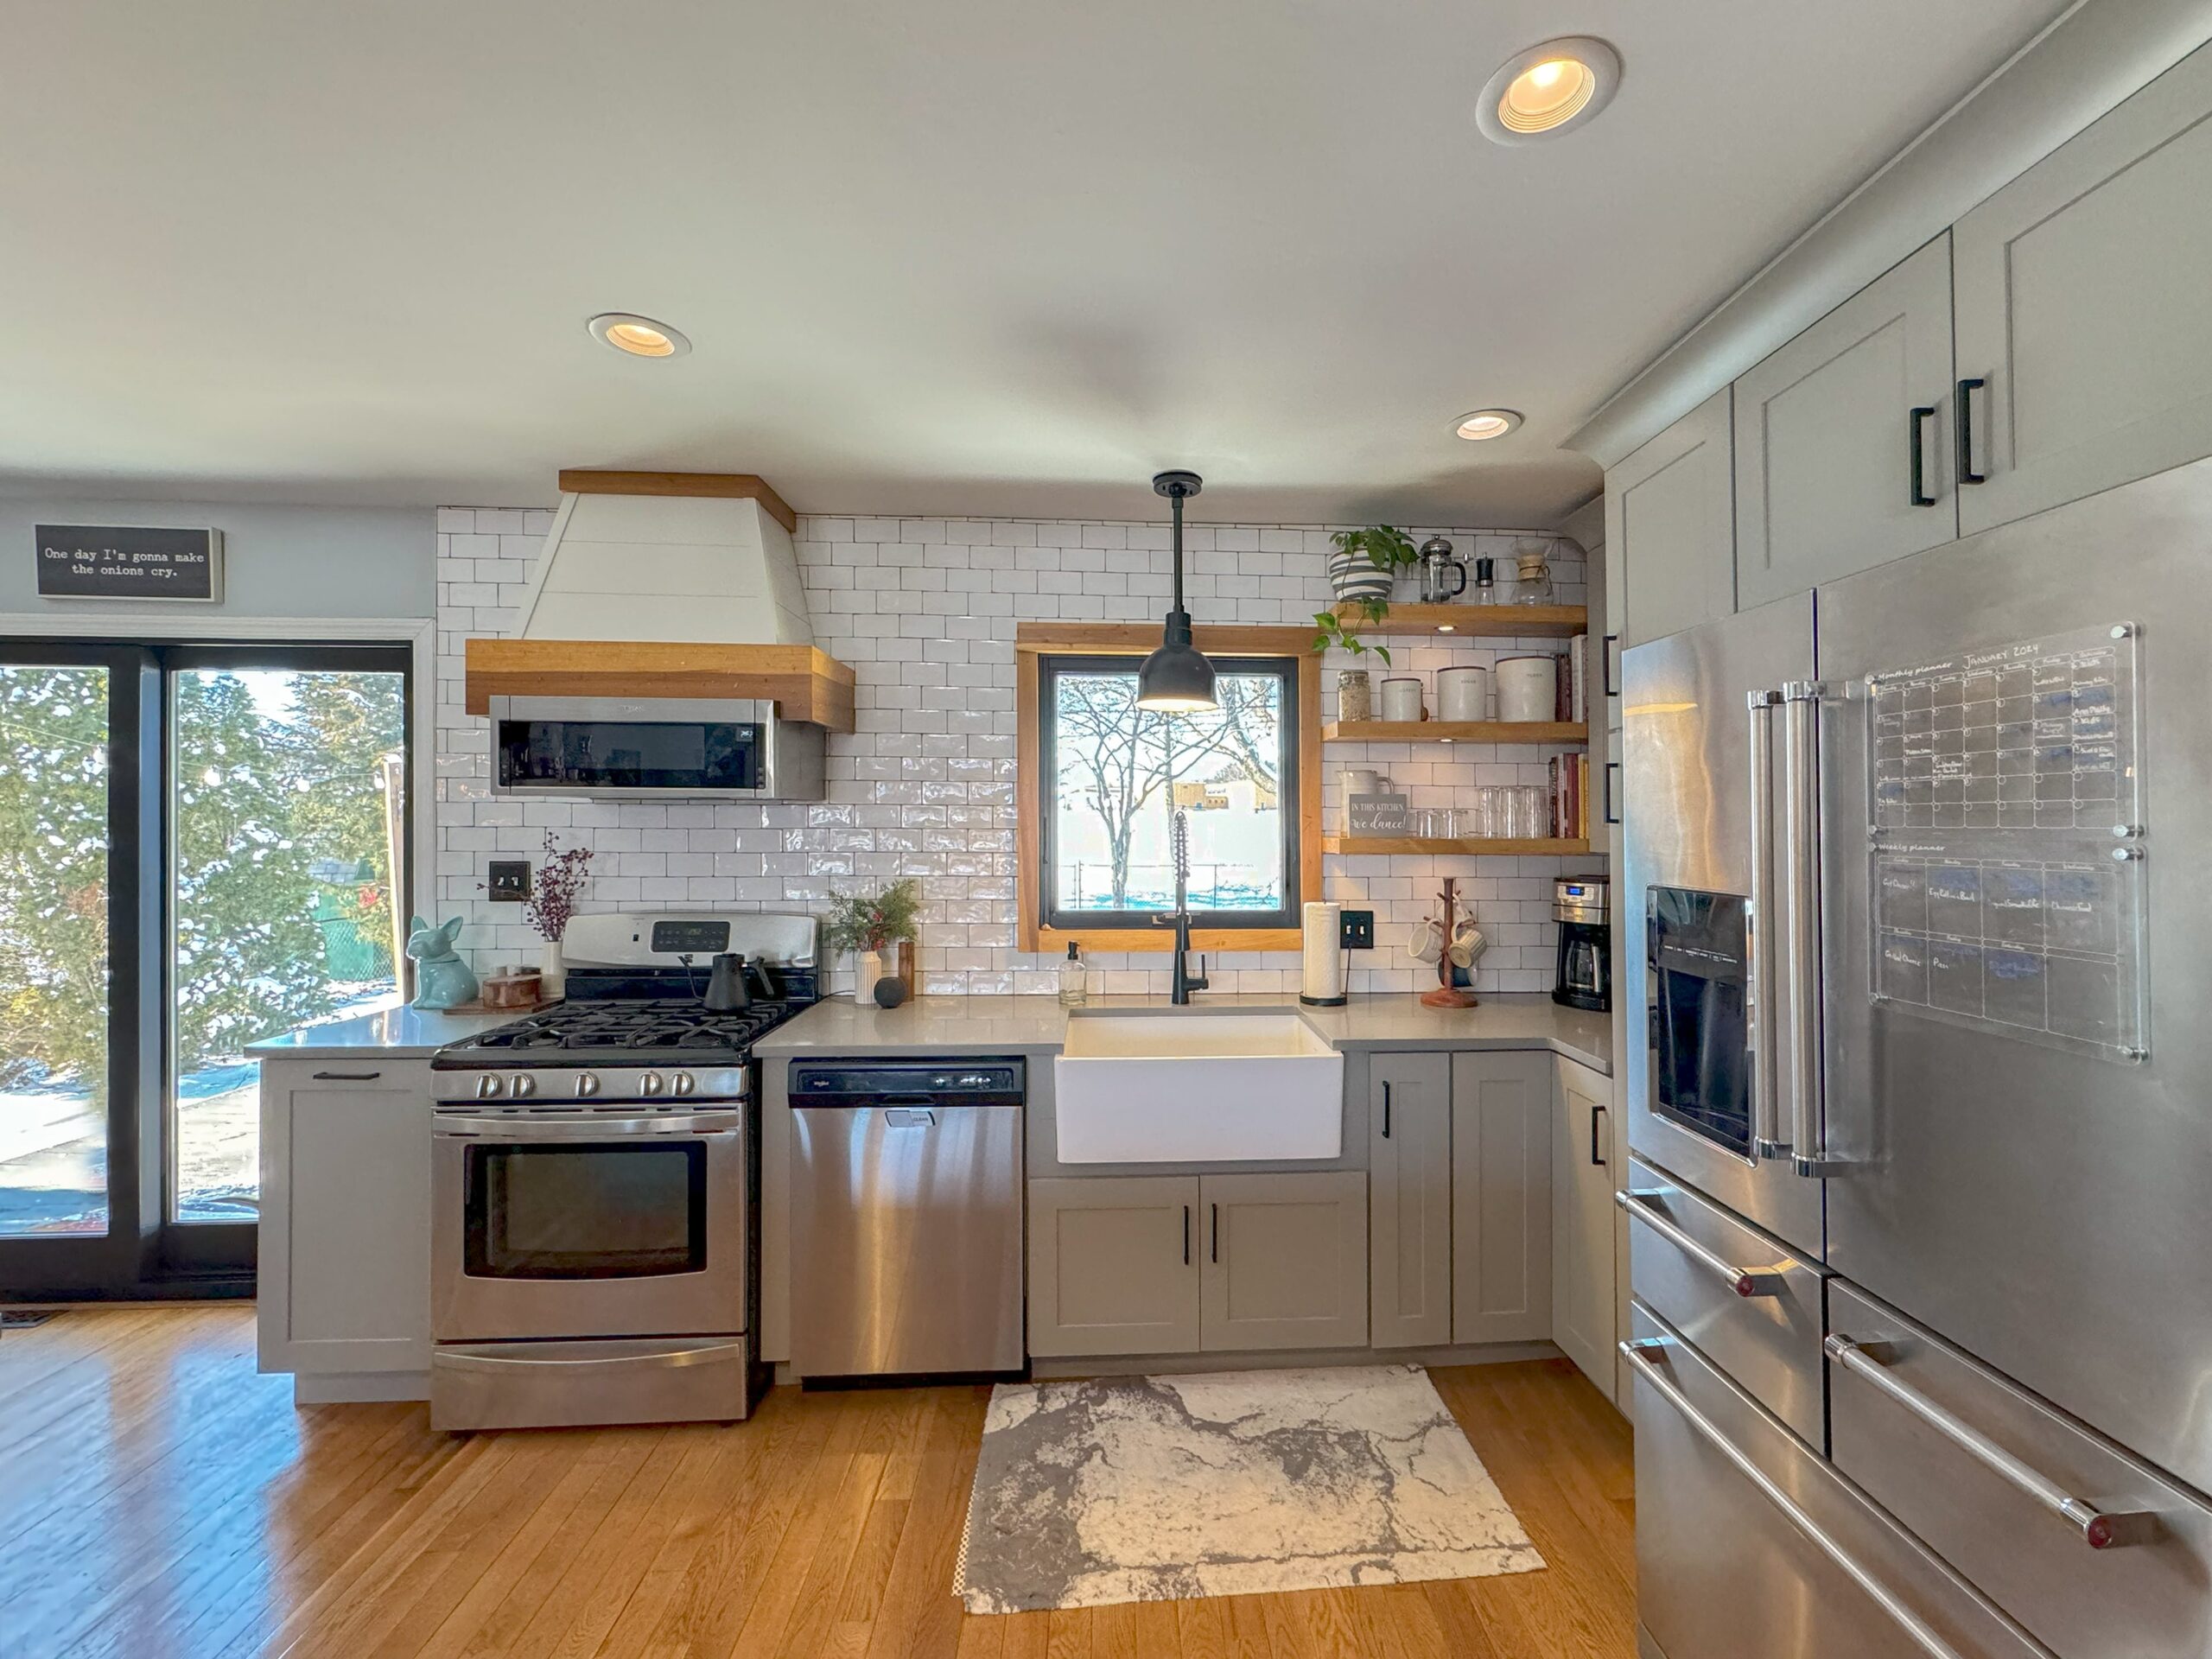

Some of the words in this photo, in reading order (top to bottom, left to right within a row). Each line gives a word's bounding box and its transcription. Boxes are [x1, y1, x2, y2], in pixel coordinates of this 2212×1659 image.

[45, 548, 68, 559] One
[74, 549, 97, 561] day
[104, 550, 126, 561] I'm
[133, 553, 168, 563] gonna
[175, 553, 204, 563] make
[72, 564, 94, 575] the
[101, 565, 144, 576] onions
[151, 568, 178, 578] cry.
[1963, 650, 2008, 670] JANUARY
[2013, 645, 2039, 657] 2024
[1878, 669, 1913, 680] Monthly
[1916, 663, 1952, 676] planner
[1351, 803, 1359, 811] IN
[1361, 803, 1376, 811] THIS
[1377, 803, 1405, 811] KITCHEN
[1370, 811, 1407, 830] dance!
[1878, 843, 1908, 852] Weekly
[1910, 844, 1946, 853] planner
